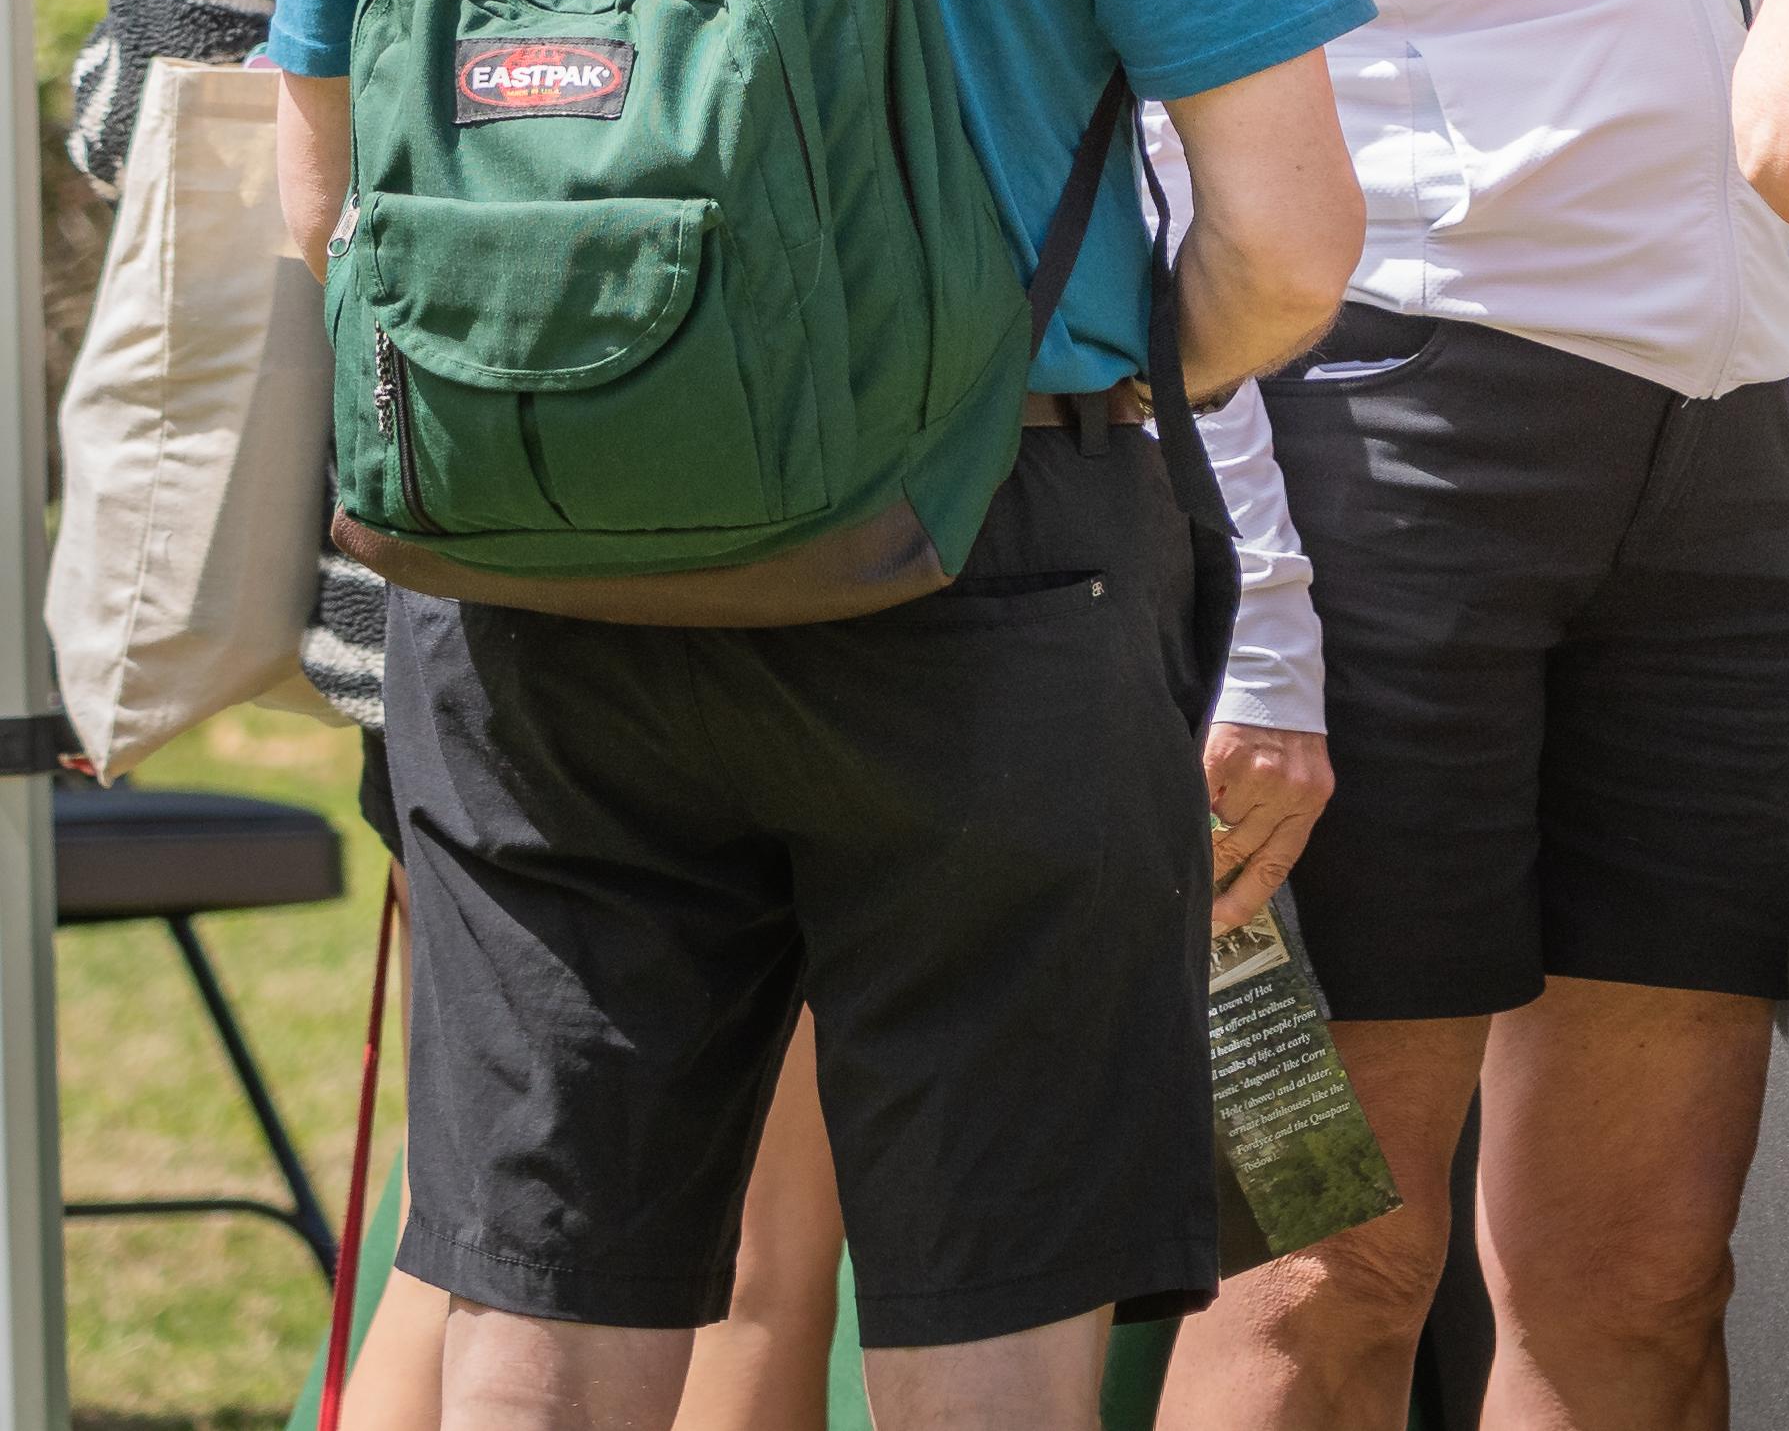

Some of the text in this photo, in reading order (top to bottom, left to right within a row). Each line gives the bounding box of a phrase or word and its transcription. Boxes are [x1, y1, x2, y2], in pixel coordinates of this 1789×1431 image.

[472, 65, 603, 90] EASTPAK
[1219, 996, 1243, 1013] town
[1244, 989, 1255, 1004] of
[1255, 984, 1273, 999] Hot
[1225, 1013, 1258, 1033] offered
[1258, 996, 1297, 1018] wellness
[1252, 1031, 1262, 1043] to
[1263, 1018, 1293, 1041] people
[1293, 1008, 1318, 1028] from
[1246, 1053, 1258, 1067] of
[1276, 1042, 1287, 1054] at
[1287, 1033, 1312, 1050] early
[1283, 1057, 1300, 1073] like
[1301, 1048, 1327, 1064] Corn
[1243, 1089, 1277, 1111] (above)
[1277, 1080, 1296, 1096] and
[1296, 1077, 1307, 1088] at
[1260, 1097, 1312, 1126] bathhouses
[1311, 1088, 1330, 1104] like
[1330, 1082, 1345, 1096] the
[1275, 1123, 1293, 1139] and
[1293, 1117, 1310, 1132] the
[1309, 1102, 1351, 1127] Quapaw
